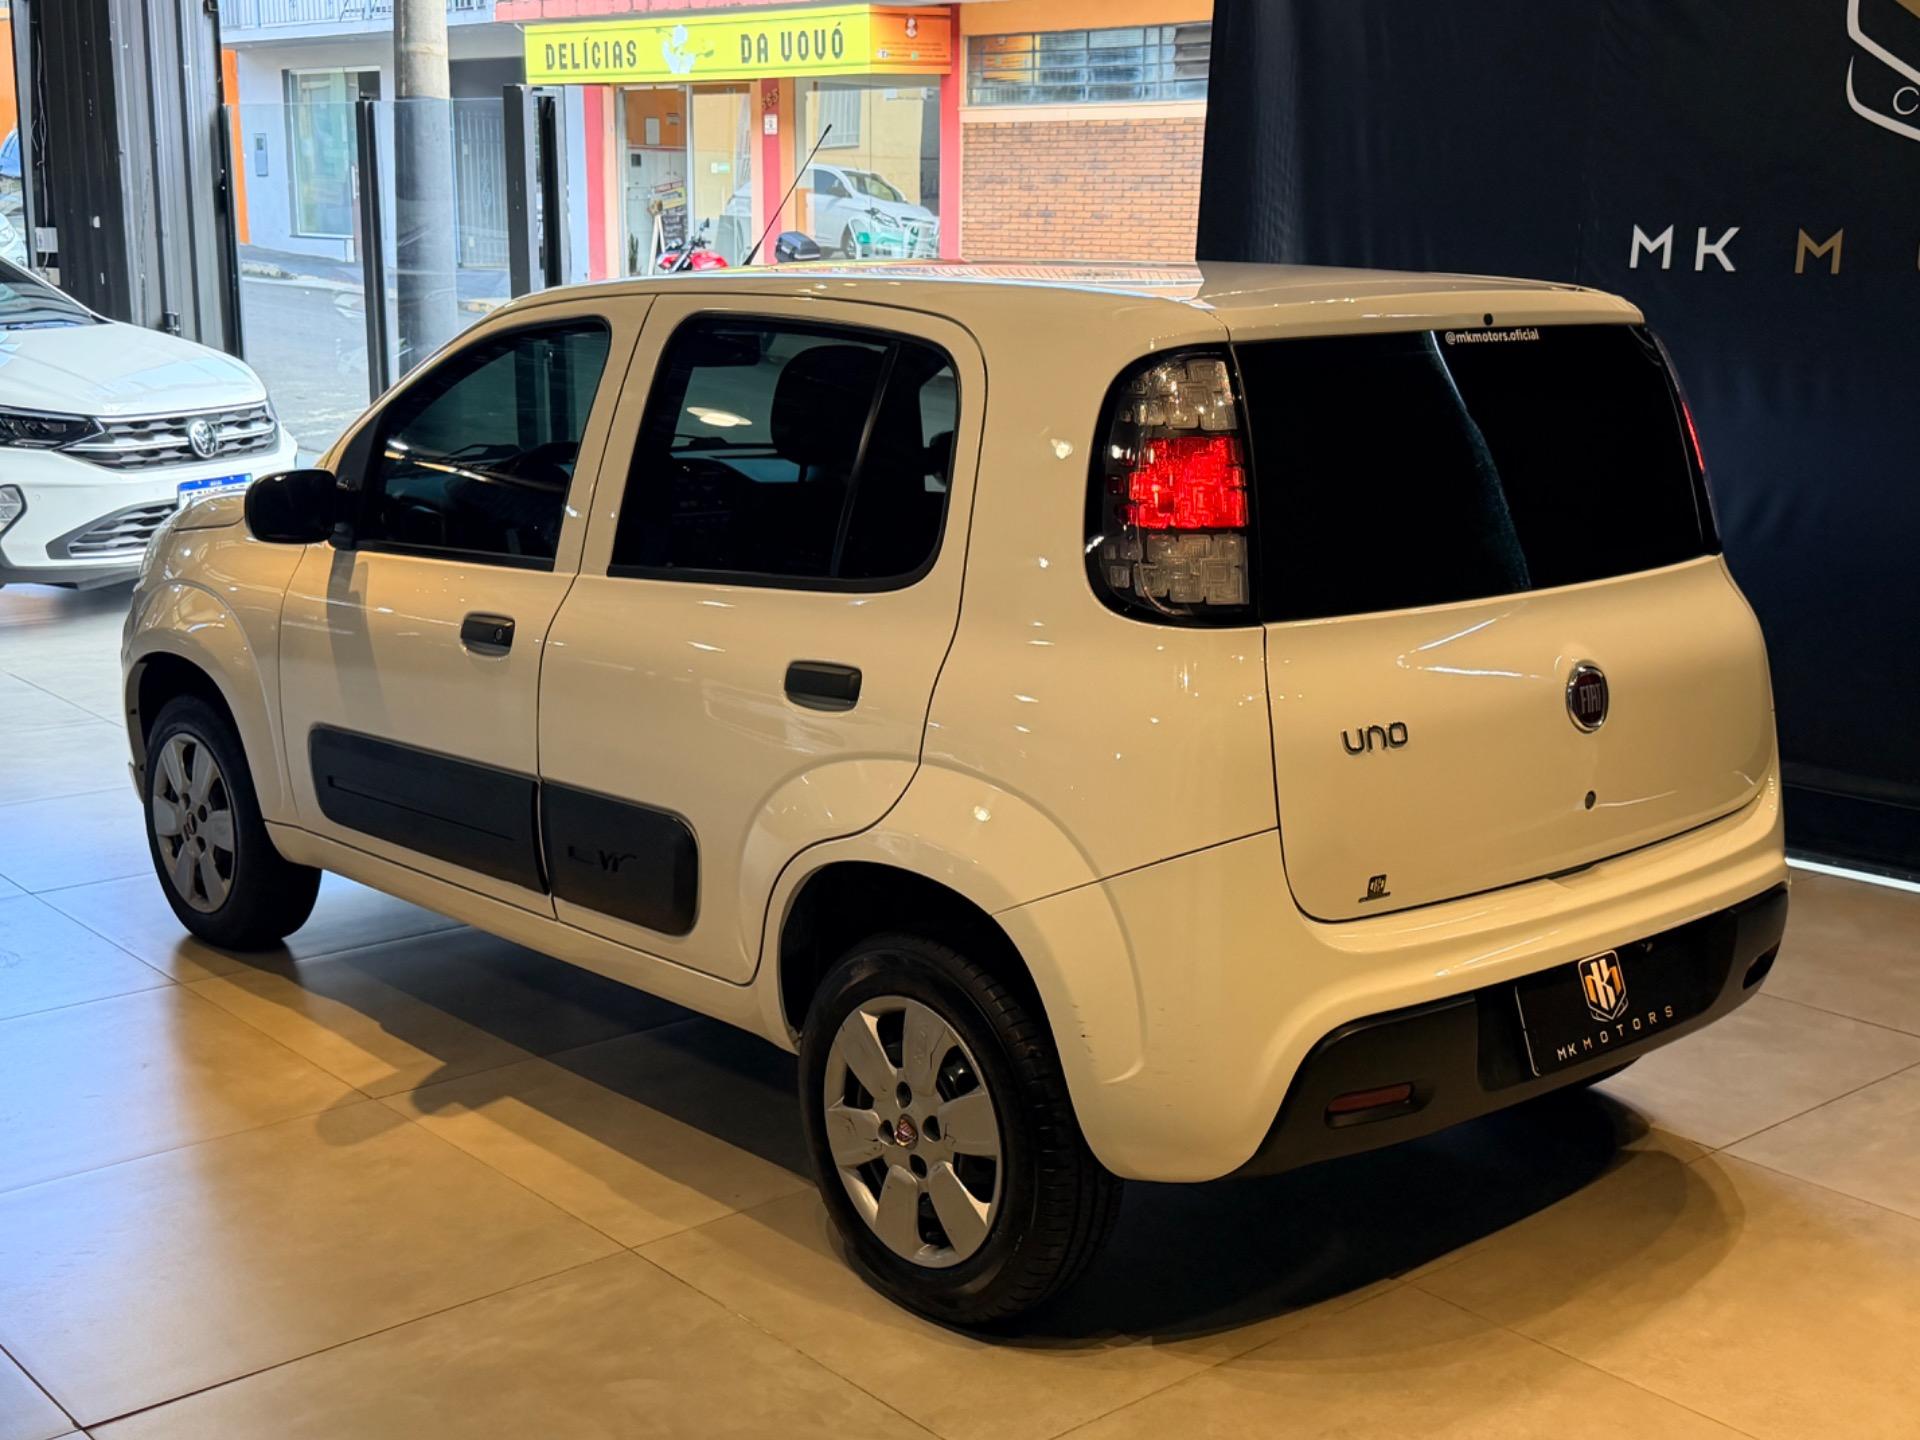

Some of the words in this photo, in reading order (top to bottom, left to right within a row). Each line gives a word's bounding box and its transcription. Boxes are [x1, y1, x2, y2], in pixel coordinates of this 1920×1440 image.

[545, 36, 637, 70] DELÍCIAS
[740, 33, 769, 64] DA
[1629, 224, 1740, 272] MK
[1444, 328, 1540, 345] @mkmotors.oficial
[1556, 1042, 1578, 1061] MK
[1582, 1005, 1674, 1051] MOTORS
